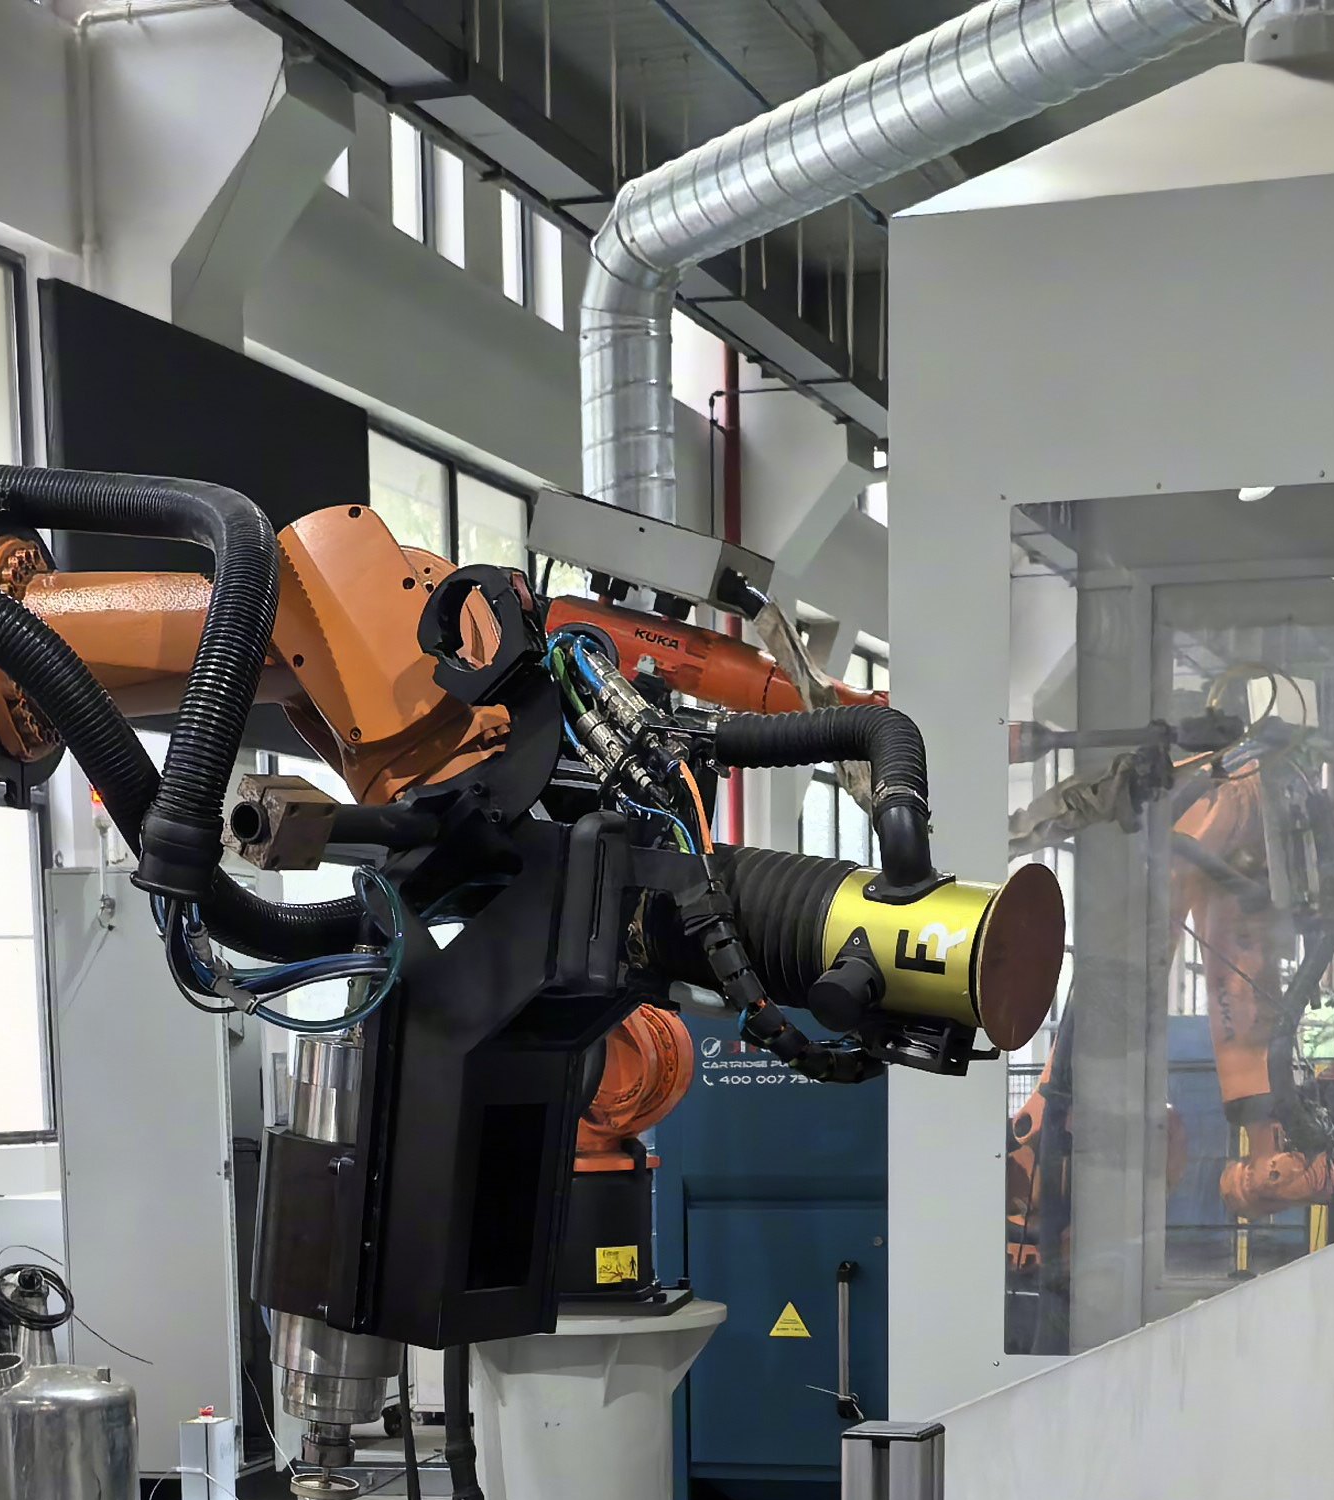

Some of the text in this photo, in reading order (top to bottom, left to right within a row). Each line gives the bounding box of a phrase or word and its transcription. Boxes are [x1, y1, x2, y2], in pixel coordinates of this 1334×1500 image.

[634, 628, 679, 650] KUKA
[701, 1060, 768, 1069] CARTRIDGE
[719, 1075, 752, 1085] 400
[755, 1075, 786, 1085] 007
